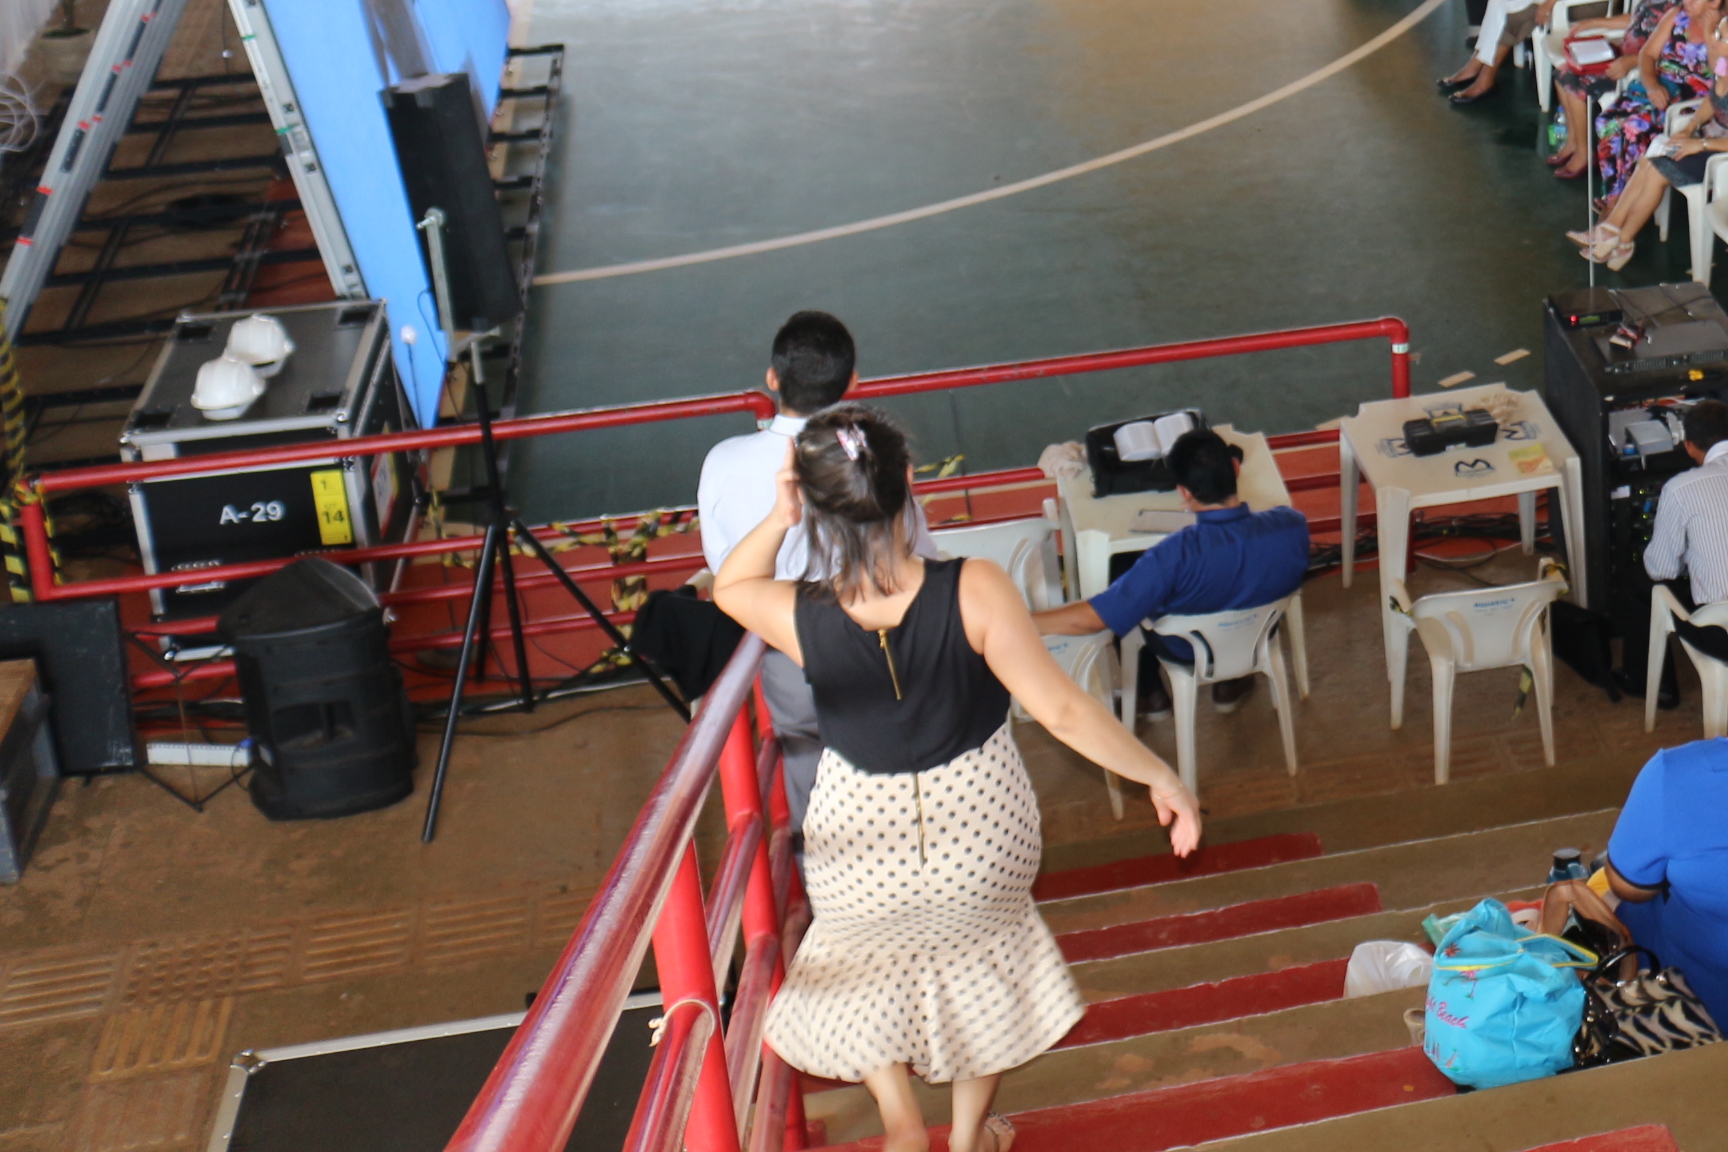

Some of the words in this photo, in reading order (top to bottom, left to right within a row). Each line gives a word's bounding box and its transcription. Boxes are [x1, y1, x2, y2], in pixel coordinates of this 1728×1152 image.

[219, 500, 284, 525] A-29
[322, 509, 345, 524] 14
[1437, 1001, 1469, 1028] Beach
